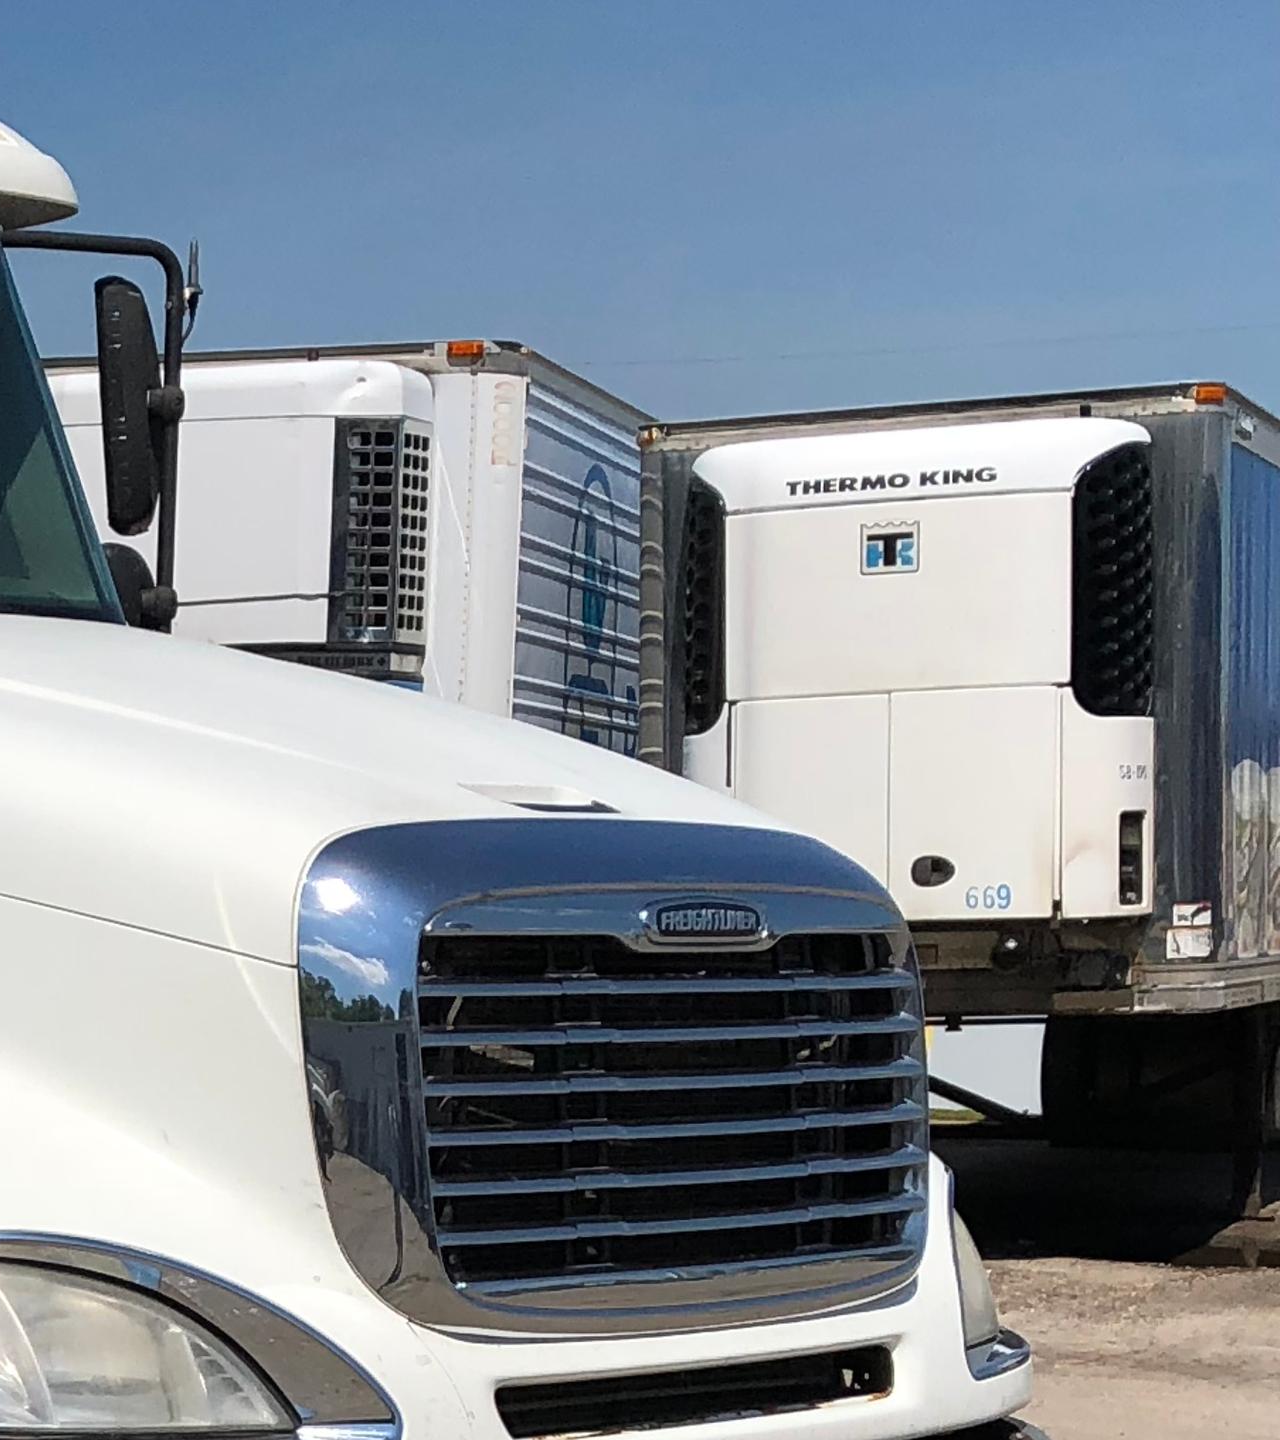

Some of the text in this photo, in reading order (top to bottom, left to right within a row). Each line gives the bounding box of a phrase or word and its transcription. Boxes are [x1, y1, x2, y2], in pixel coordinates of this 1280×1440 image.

[786, 466, 998, 497] THERMO KING
[965, 884, 1012, 909] 669
